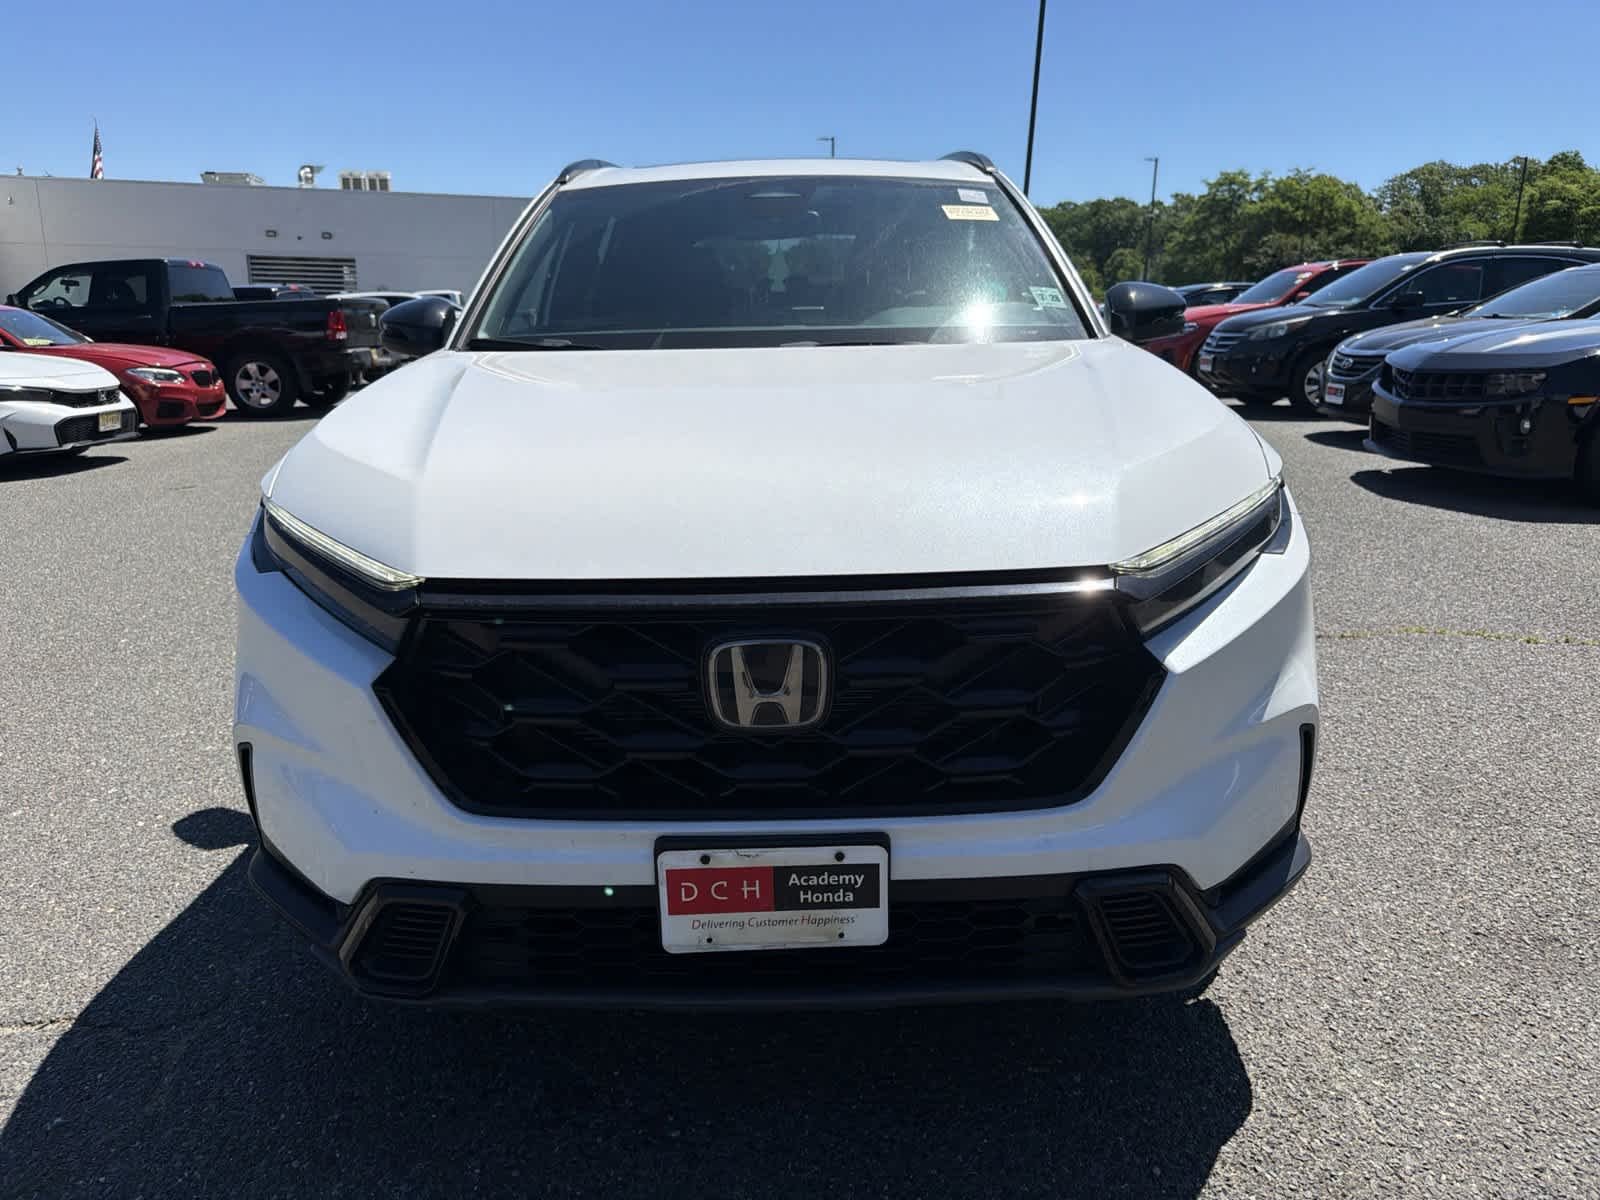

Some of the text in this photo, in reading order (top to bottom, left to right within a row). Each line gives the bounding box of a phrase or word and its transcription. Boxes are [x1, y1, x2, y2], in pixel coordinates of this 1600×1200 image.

[788, 871, 865, 889] Academy
[800, 888, 854, 904] Honda
[690, 914, 856, 931] Delivering Customer Happiness
